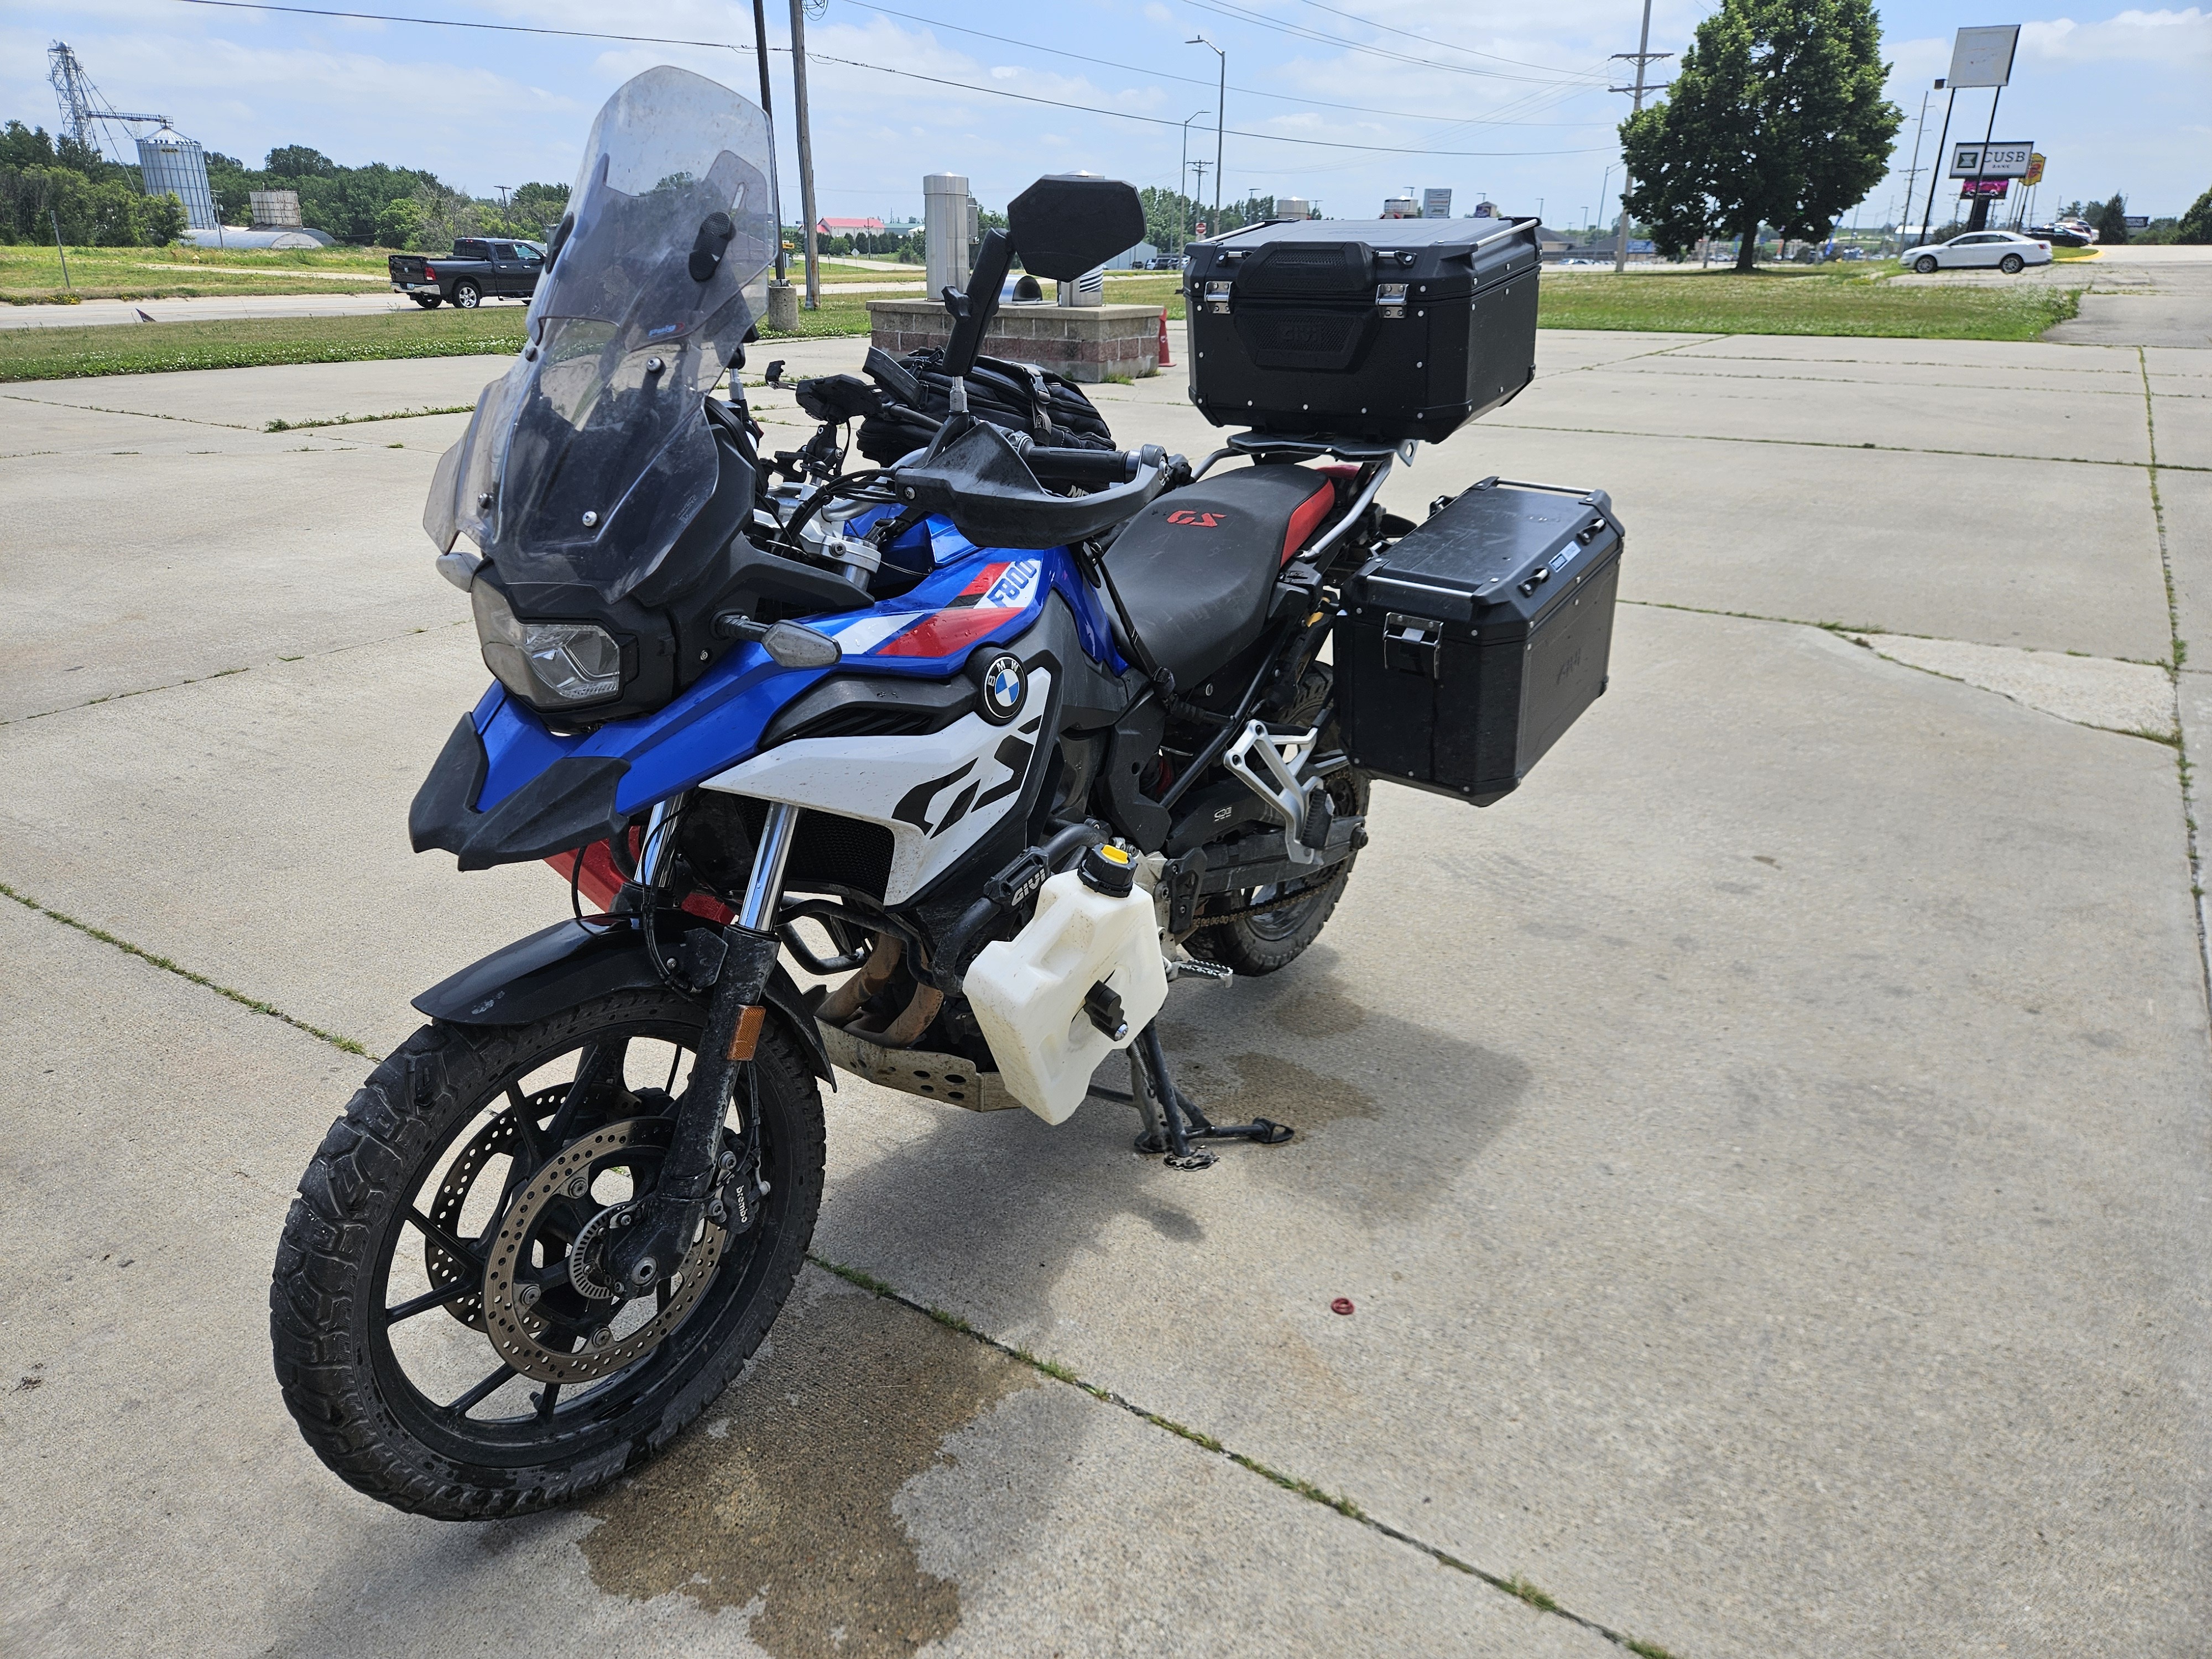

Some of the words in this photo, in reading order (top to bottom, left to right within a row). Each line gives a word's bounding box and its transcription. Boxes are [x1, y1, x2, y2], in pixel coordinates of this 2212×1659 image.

[1984, 151, 2025, 163] CUSB
[1166, 510, 1227, 527] GS
[987, 660, 1019, 687] BMW
[891, 714, 1042, 840] GS
[1011, 868, 1046, 906] GIVI
[736, 1185, 748, 1223] brembo
